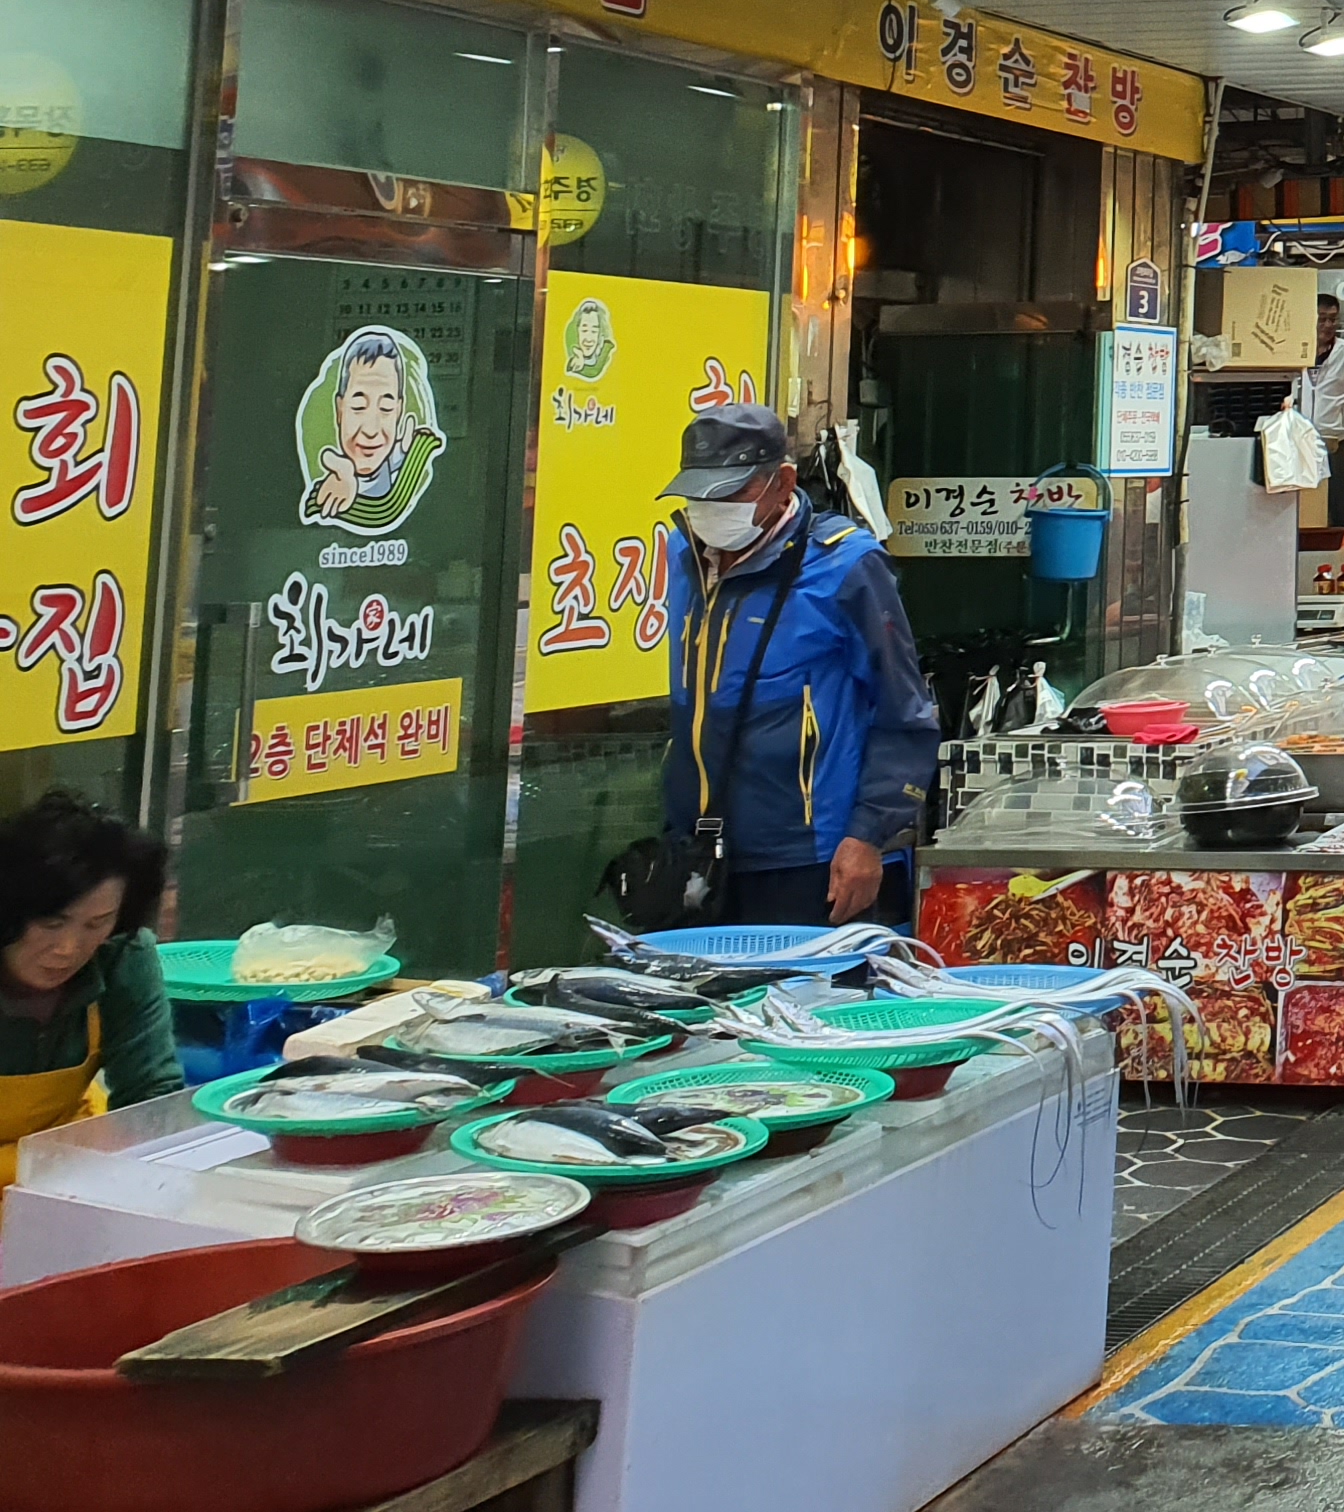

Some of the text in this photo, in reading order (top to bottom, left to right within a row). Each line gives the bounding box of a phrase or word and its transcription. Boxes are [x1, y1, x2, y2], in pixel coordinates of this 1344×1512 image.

[878, 1, 1037, 110] 이경순
[1138, 290, 1149, 314] 3
[14, 354, 138, 526] 회
[904, 485, 999, 518] 이경순
[321, 543, 406, 566] since1989
[0, 569, 124, 734] 집
[270, 575, 431, 687] 최가네
[249, 704, 450, 778] 2층 단체석 완비
[1214, 935, 1306, 989] 찬방
